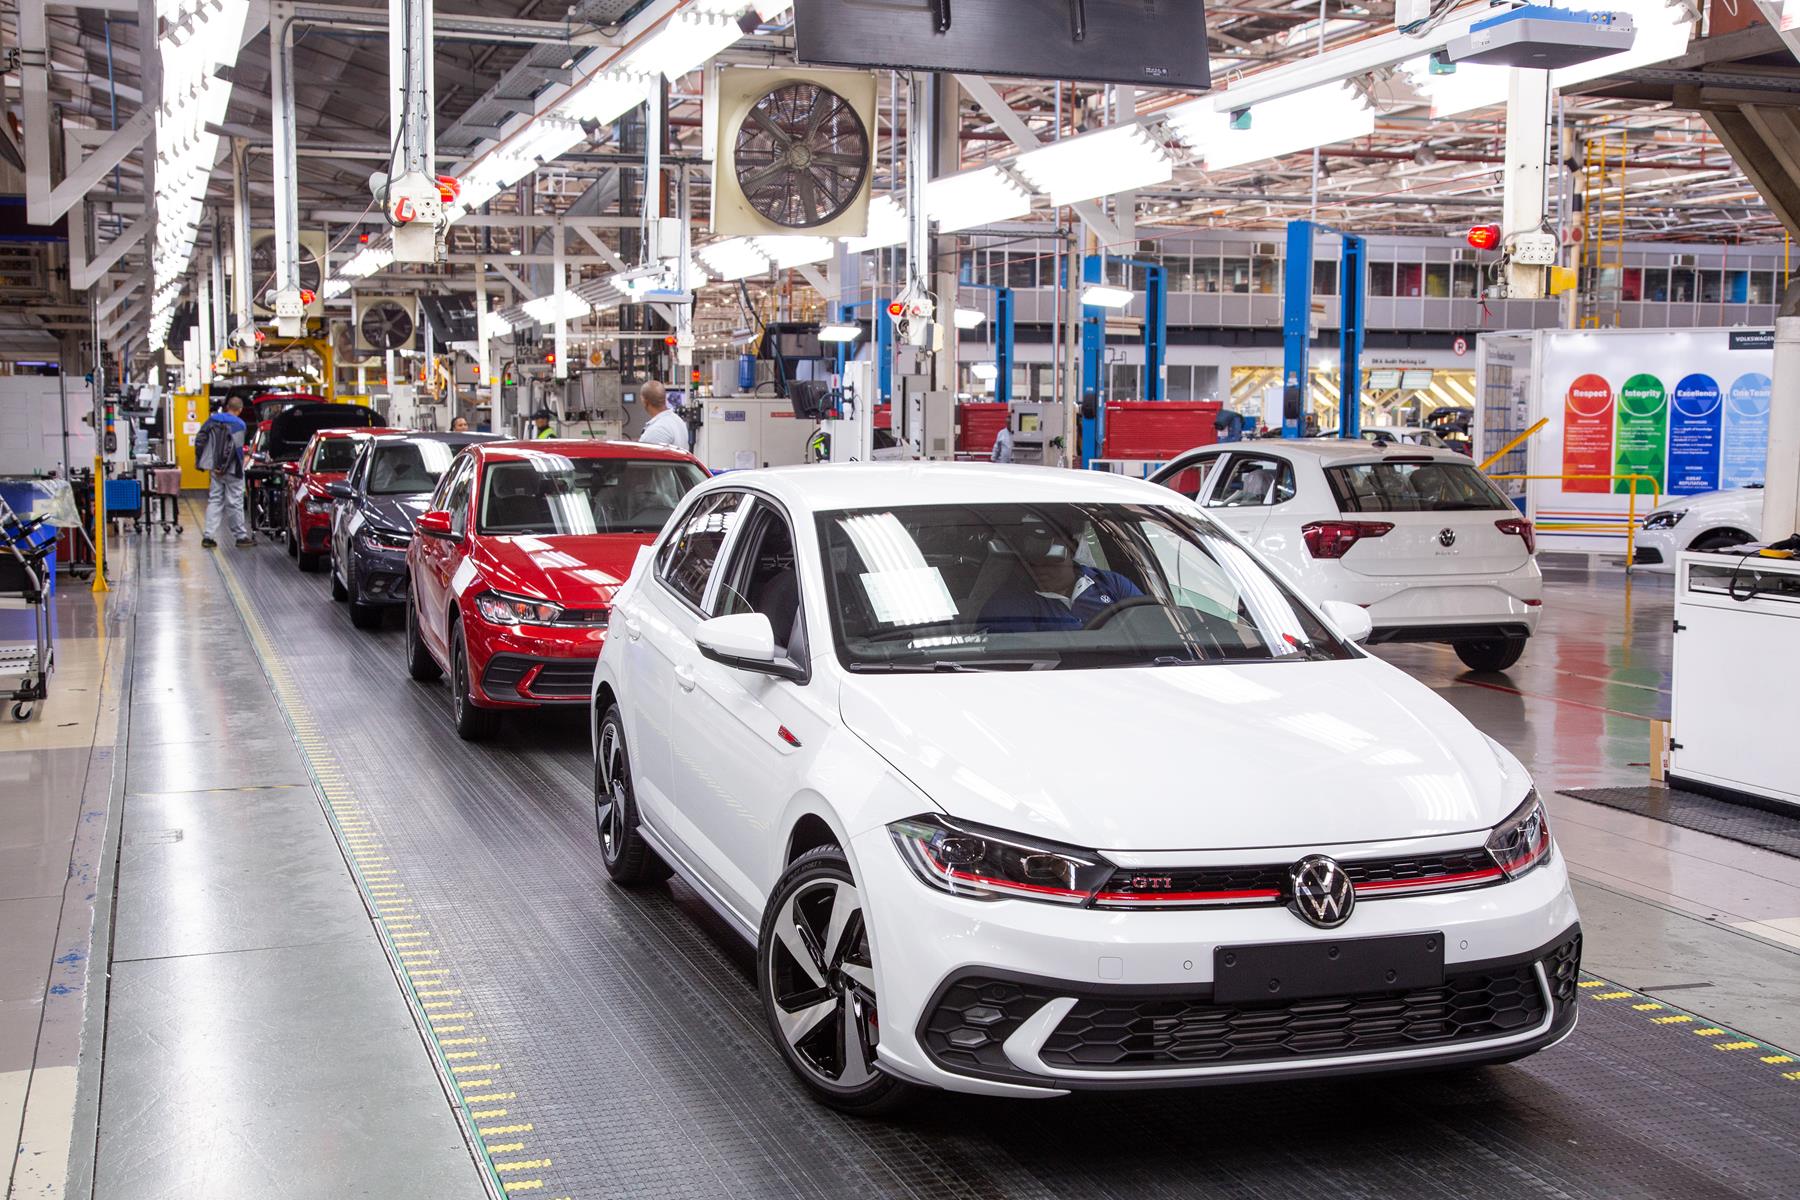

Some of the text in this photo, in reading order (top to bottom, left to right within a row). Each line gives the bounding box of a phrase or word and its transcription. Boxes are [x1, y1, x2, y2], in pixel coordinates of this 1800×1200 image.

[1573, 389, 1608, 398] Respect
[1624, 389, 1661, 399] Integrity
[1677, 389, 1718, 397] Excellence
[1132, 877, 1171, 889] GTI
[1296, 858, 1354, 927] VW
